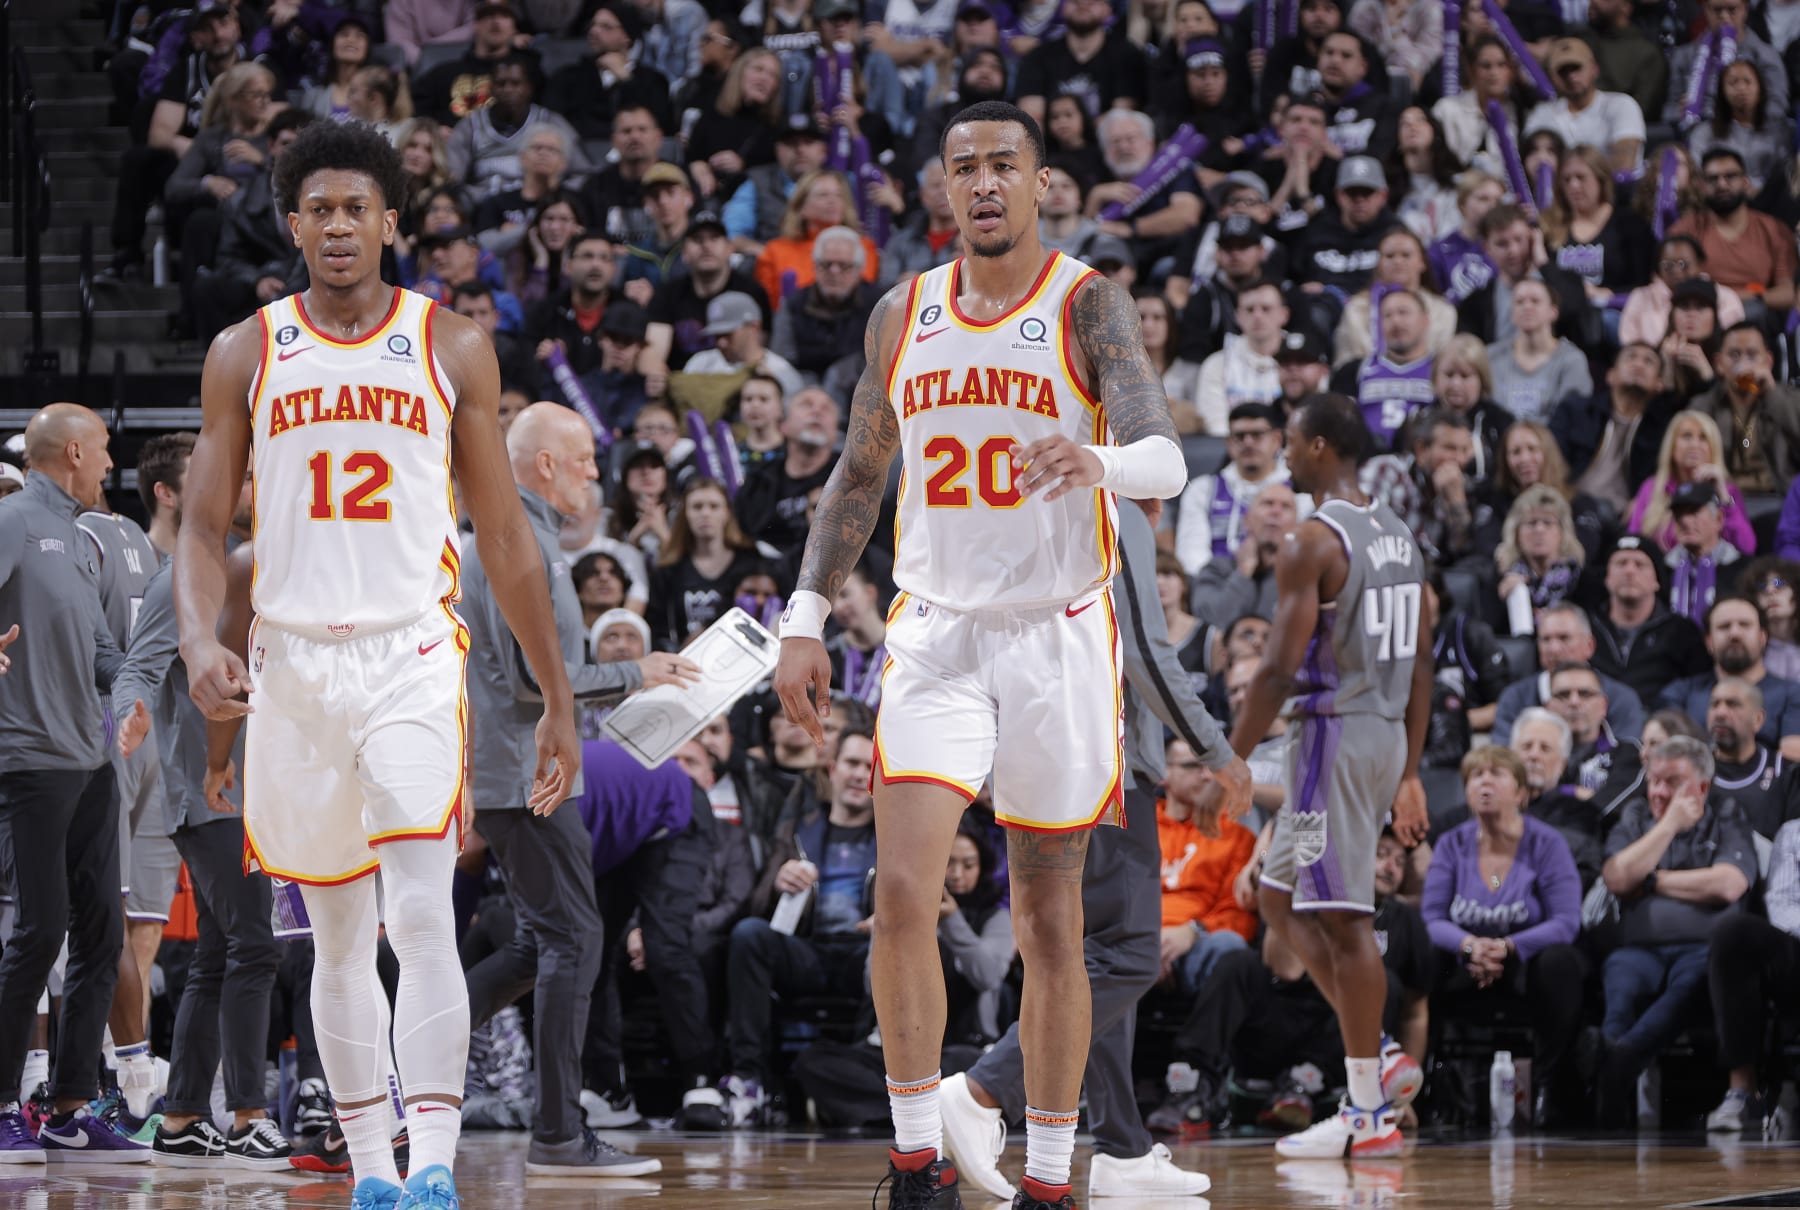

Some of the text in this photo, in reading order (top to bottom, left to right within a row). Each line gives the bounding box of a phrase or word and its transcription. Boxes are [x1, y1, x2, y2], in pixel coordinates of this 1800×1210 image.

[280, 327, 291, 344] 6
[924, 307, 938, 324] 6
[380, 354, 416, 365] sharecare
[1011, 341, 1051, 352] sharecare
[269, 383, 430, 440] ATLANTA
[903, 365, 1061, 422] ATLANTA
[306, 449, 393, 523] 12
[923, 434, 1027, 510] 20
[1364, 581, 1422, 662] 40
